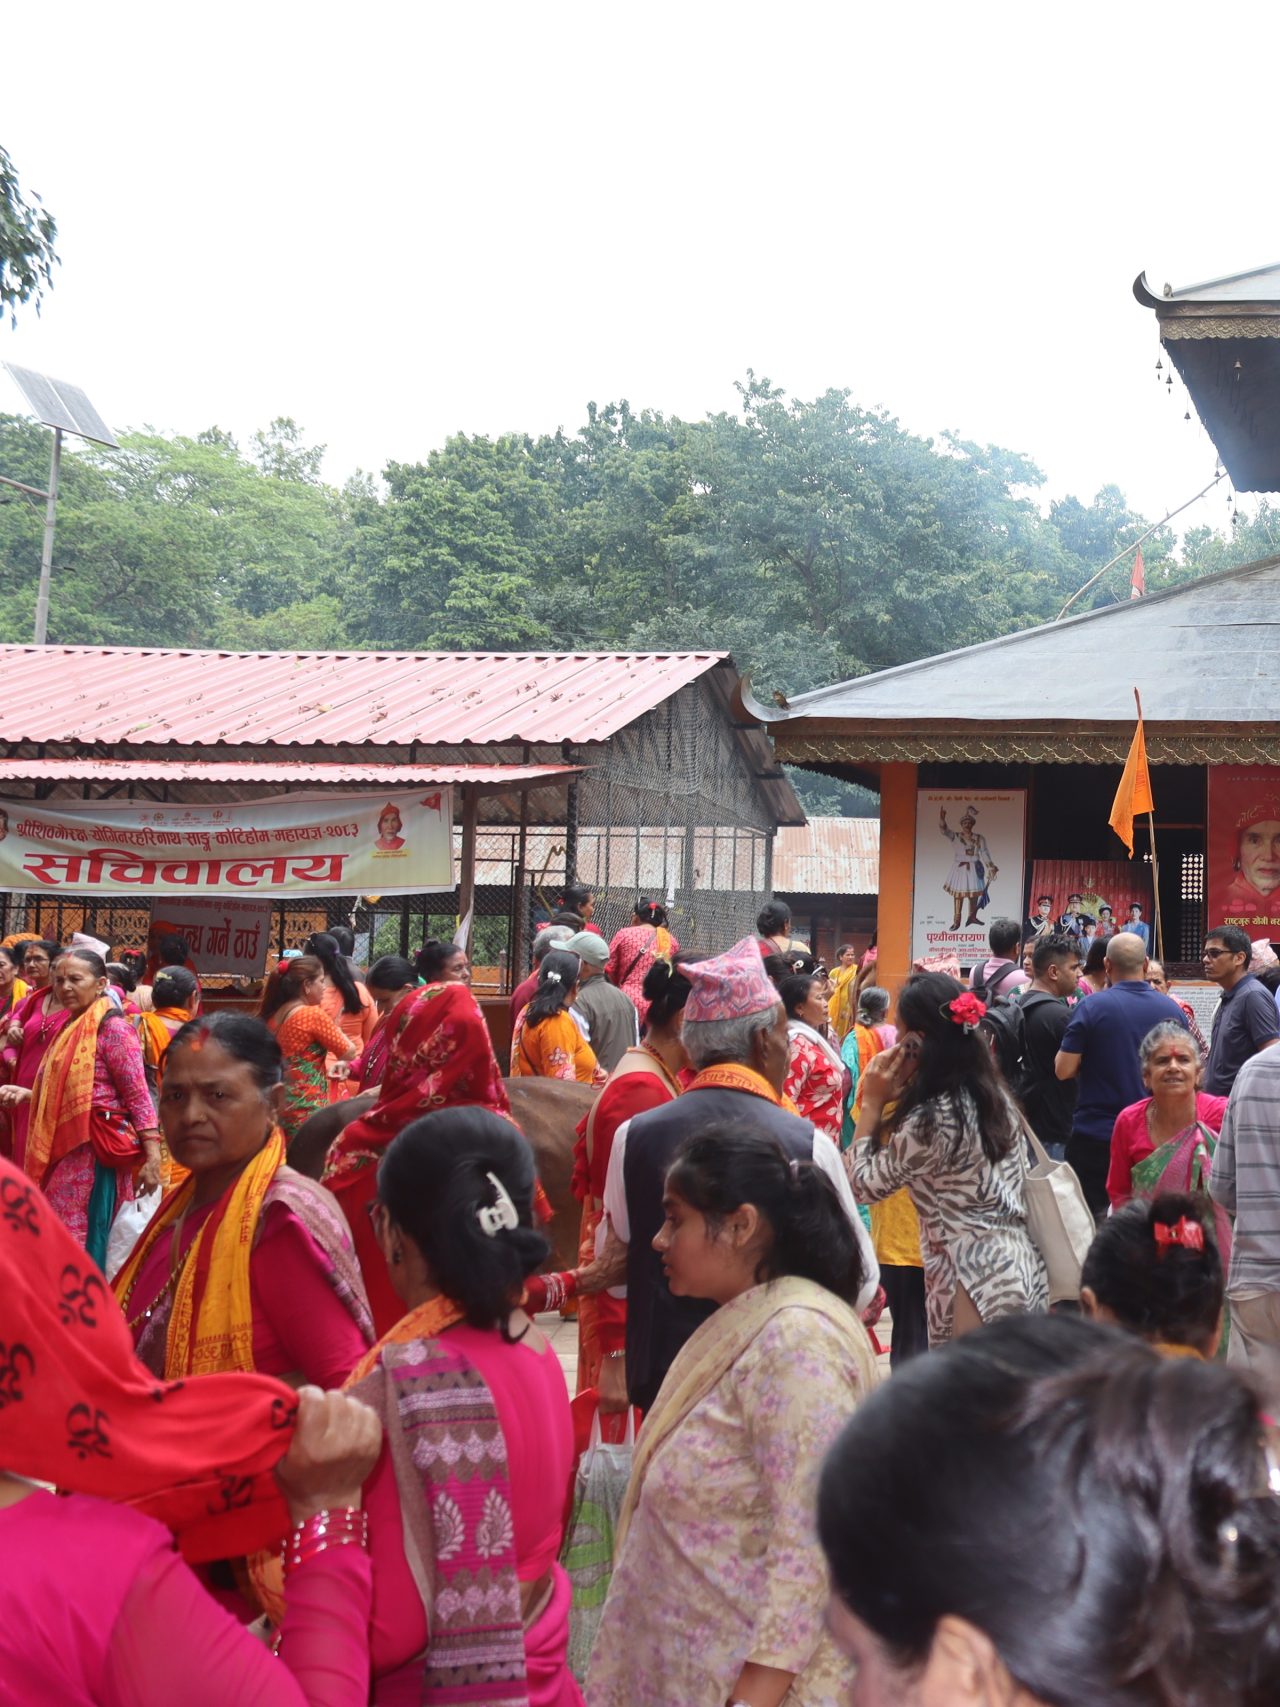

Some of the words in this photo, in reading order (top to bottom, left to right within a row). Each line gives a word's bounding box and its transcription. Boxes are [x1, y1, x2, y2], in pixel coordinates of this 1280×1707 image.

[23, 848, 349, 886] सचिवालय
[206, 917, 233, 957] गर्ने
[233, 919, 260, 960] ठाउँ
[927, 931, 985, 944] पृथ्वीनारायण
